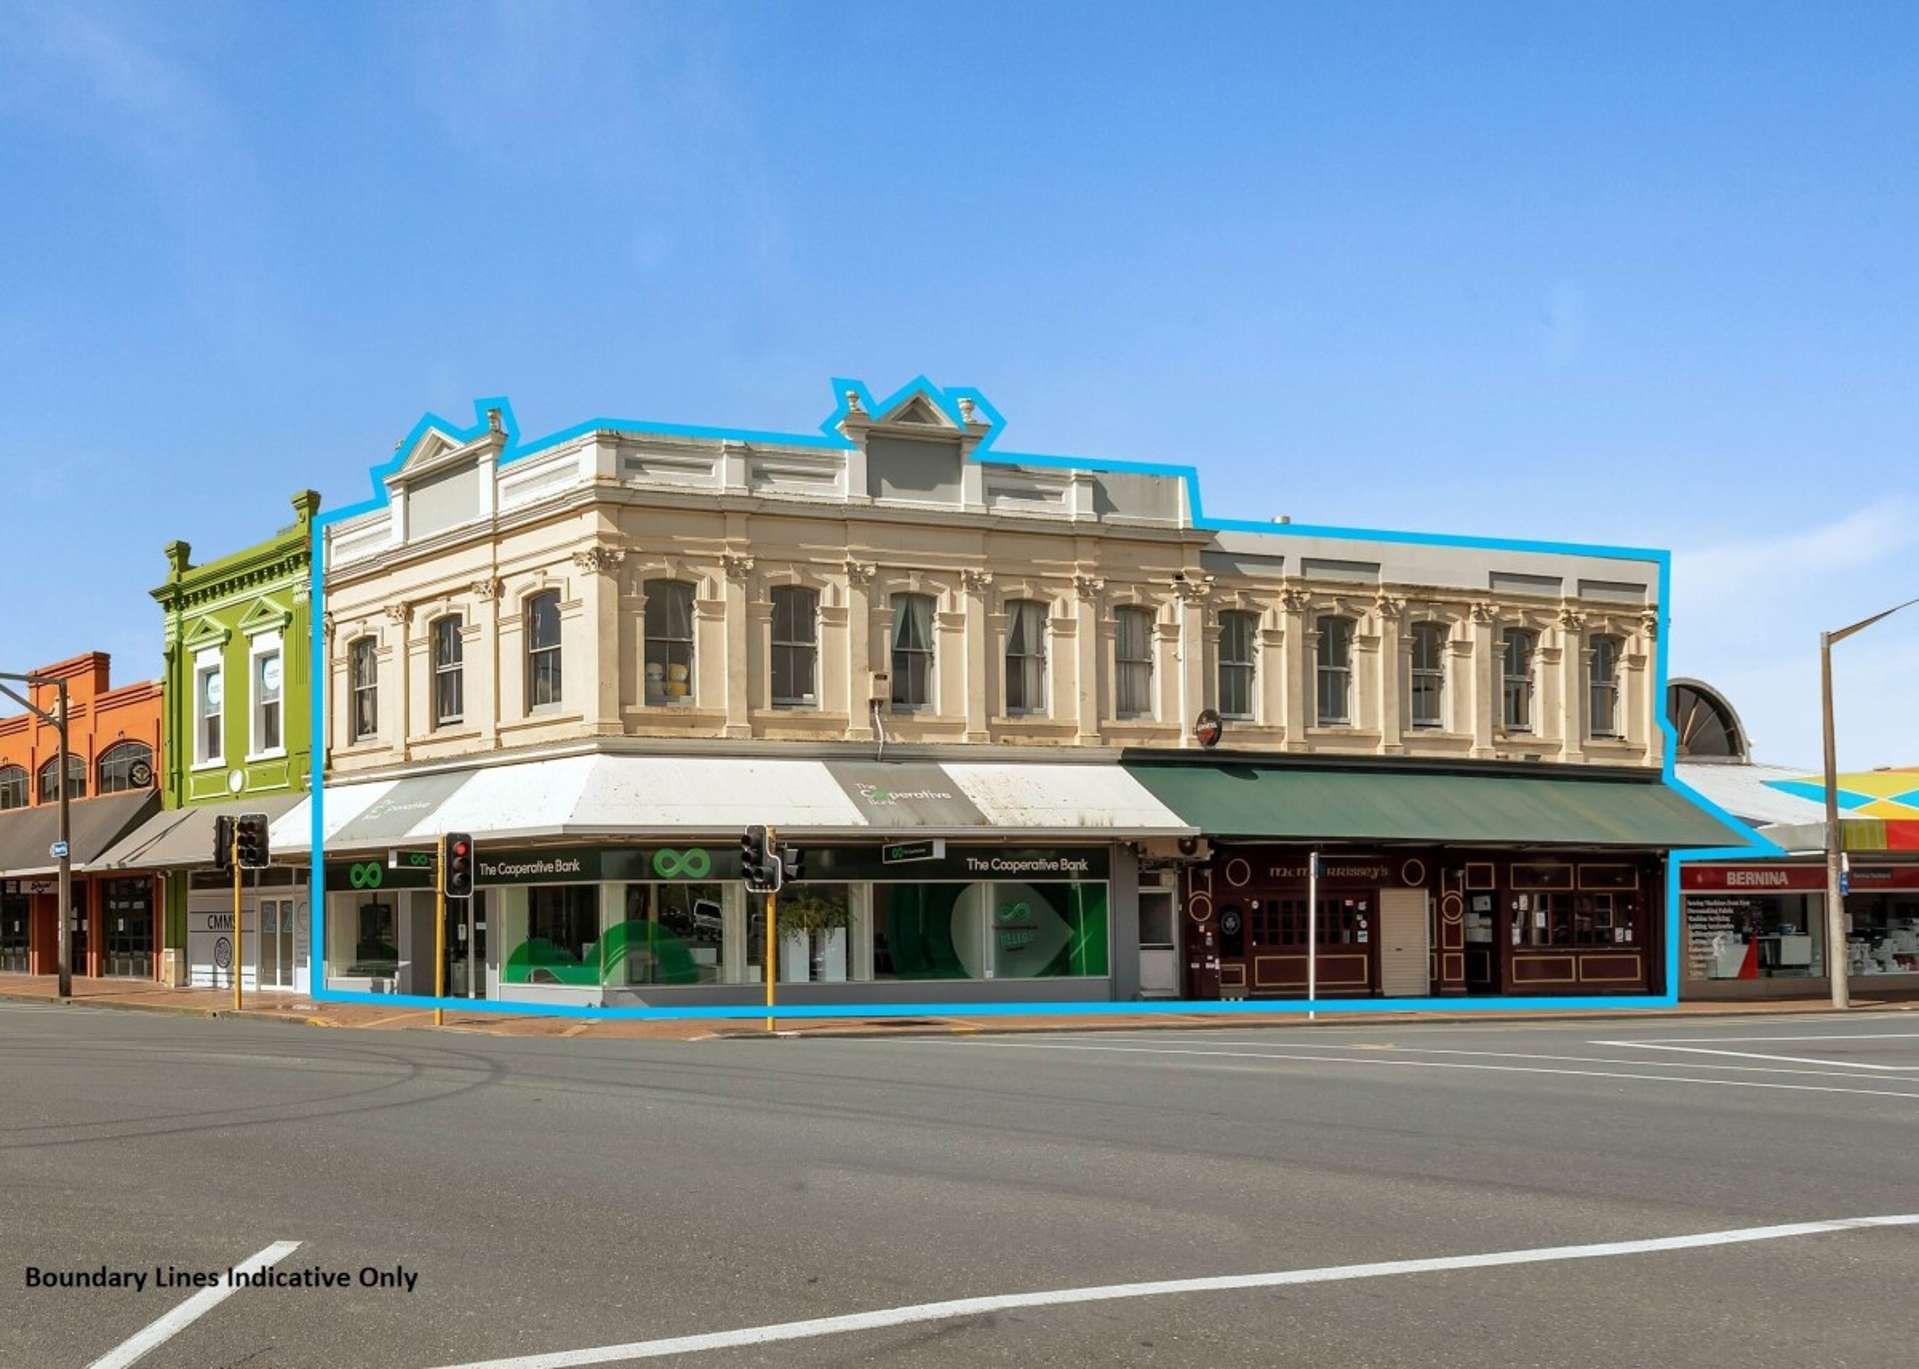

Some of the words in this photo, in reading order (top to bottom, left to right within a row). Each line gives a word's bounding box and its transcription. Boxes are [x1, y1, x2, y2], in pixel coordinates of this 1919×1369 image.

[479, 862, 497, 876] The
[498, 860, 554, 878] Cooperative
[555, 858, 581, 873] Bank
[966, 857, 990, 871] The
[991, 857, 1059, 874] Cooperative
[1060, 857, 1089, 871] Bank
[1726, 871, 1789, 886] BERNINA
